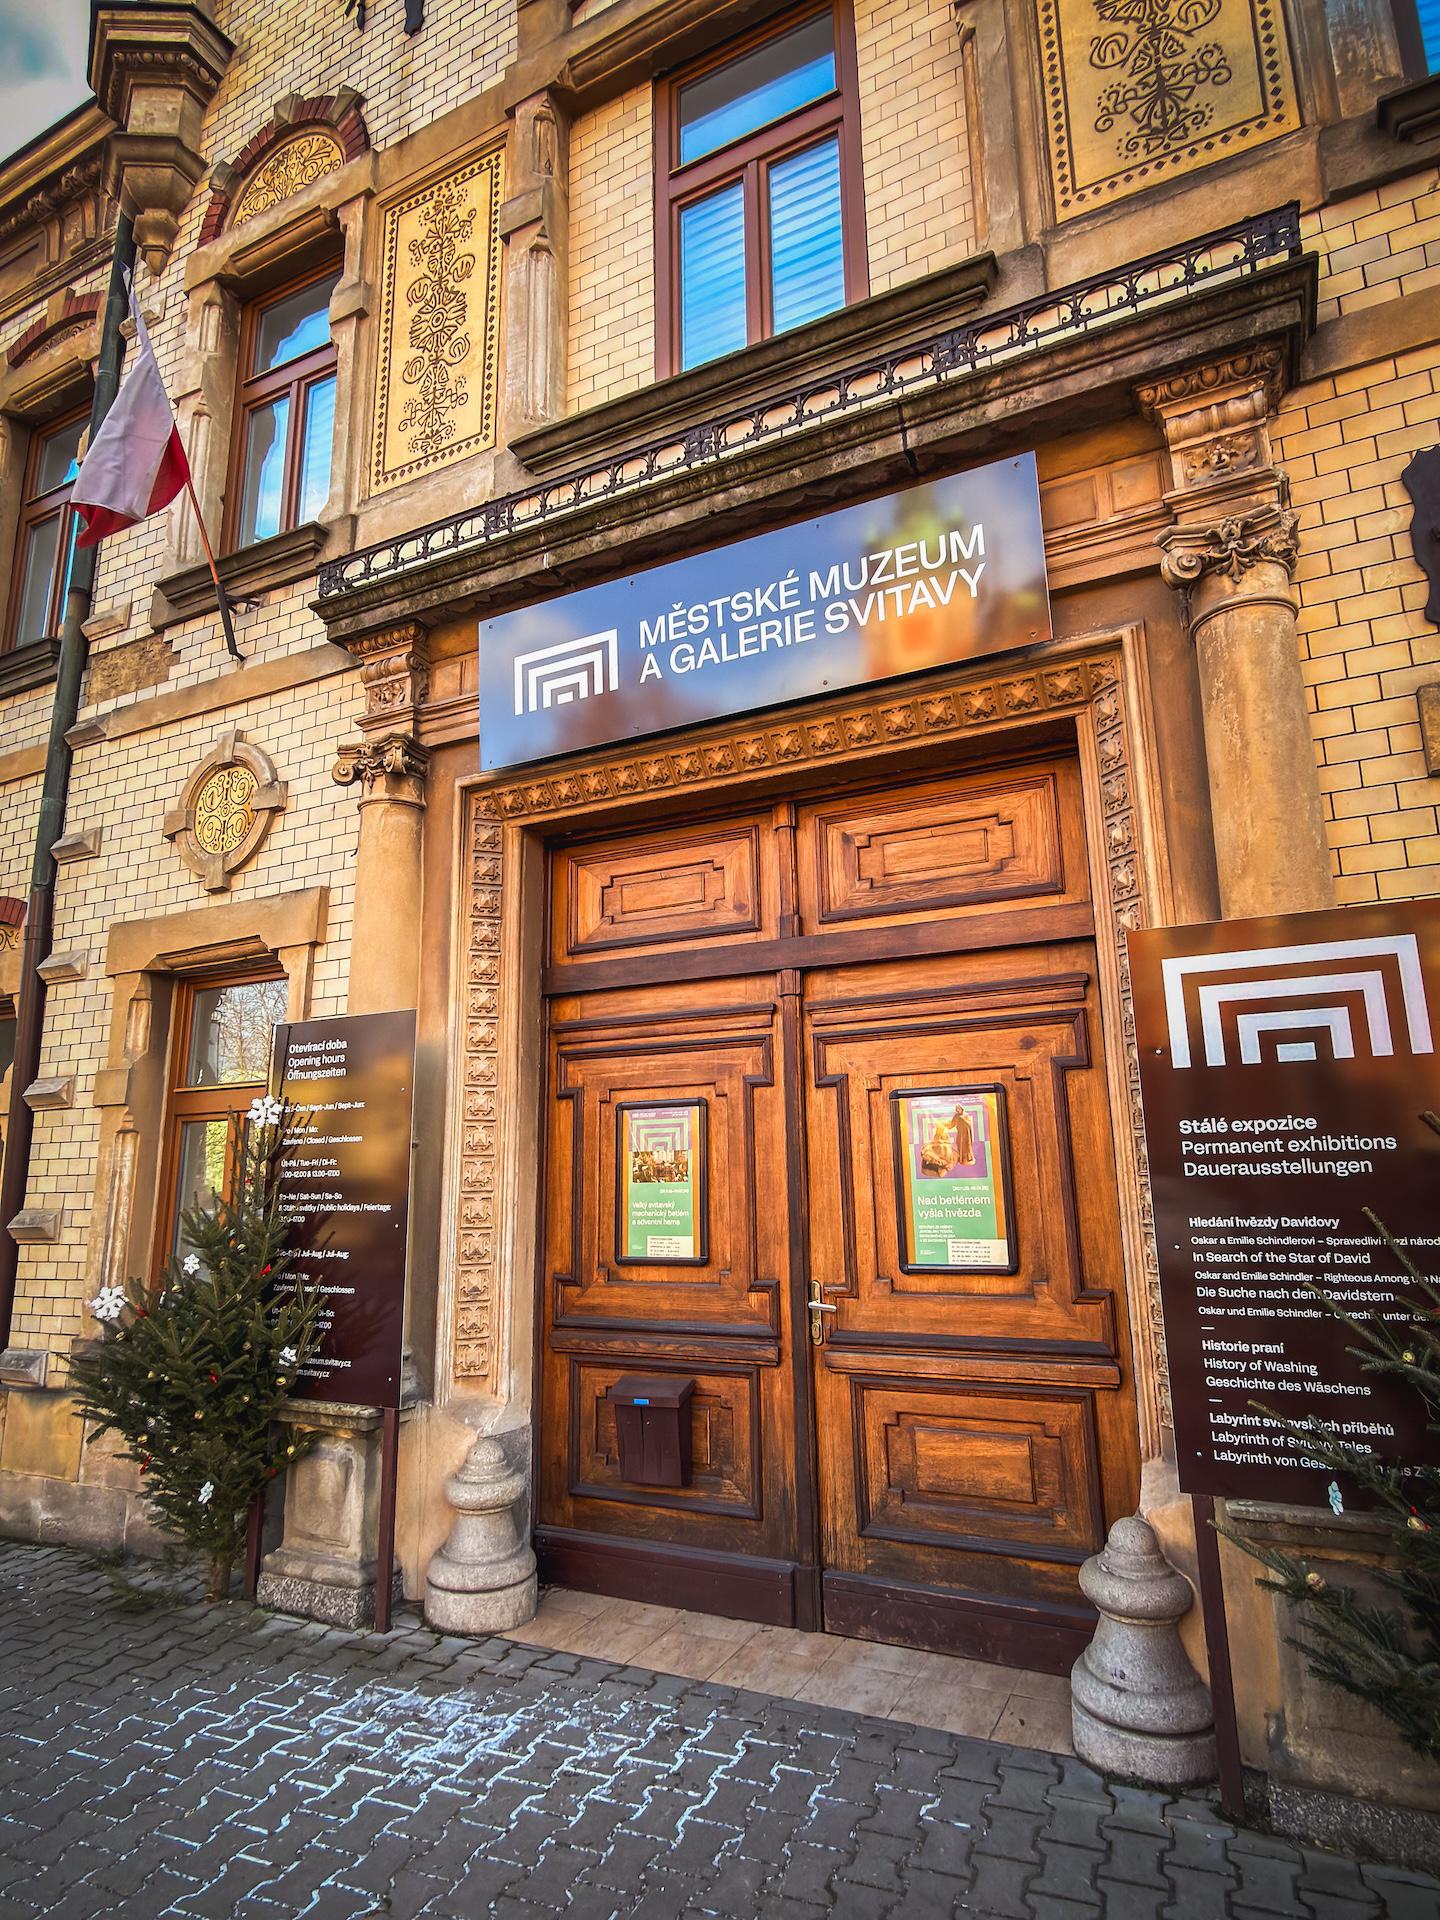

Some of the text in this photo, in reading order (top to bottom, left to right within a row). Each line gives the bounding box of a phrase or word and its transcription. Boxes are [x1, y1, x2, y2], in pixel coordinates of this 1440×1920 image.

[640, 524, 985, 649] MĚSTSKÉ MUZEUM
[640, 564, 986, 684] A GALERIE SVITAVY
[290, 1039, 348, 1054] Otevírací doba
[288, 1054, 346, 1068] Opening hours
[287, 1068, 346, 1080] Öffnungszeiten
[1179, 1114, 1317, 1134] Stálé expozice
[1182, 1135, 1397, 1155] Permanent exhibitions
[1184, 1158, 1373, 1177] Dauerausstellungen
[918, 1195, 990, 1205] Nad betlémem
[945, 1208, 982, 1218] hvězda
[1189, 1216, 1340, 1230] Hledání hvězdy Davidovy
[1191, 1236, 1218, 1245] Oskar
[1227, 1236, 1255, 1245] Emilie
[1256, 1236, 1315, 1246] Schindlerovi
[1193, 1252, 1371, 1264] In Search of the Star of David
[1195, 1271, 1221, 1280] Oskar
[1222, 1272, 1240, 1280] and
[1241, 1272, 1268, 1280] Emilie
[1270, 1272, 1313, 1281] Schindler
[1324, 1273, 1372, 1284] Righteous
[1374, 1274, 1410, 1285] Among
[1197, 1287, 1216, 1297] Die
[1218, 1287, 1256, 1298] Suche
[1259, 1288, 1289, 1299] nach
[1323, 1290, 1394, 1301] Davidstern
[1198, 1306, 1225, 1315] Oskar
[1227, 1307, 1245, 1316] und
[1247, 1308, 1275, 1317] Emilie
[1276, 1308, 1322, 1318] Schindler
[1383, 1312, 1411, 1321] unter
[1202, 1340, 1284, 1355] Historie praní
[1204, 1358, 1318, 1376] History of Washing
[1206, 1376, 1371, 1396] Geschichte des Wäschens
[1210, 1413, 1261, 1427] Labyrint
[1342, 1421, 1395, 1436] příběhů
[1212, 1432, 1269, 1446] Labyrinth
[1272, 1436, 1284, 1447] of
[1214, 1450, 1271, 1465] Labyrinth
[1274, 1456, 1298, 1467] von
